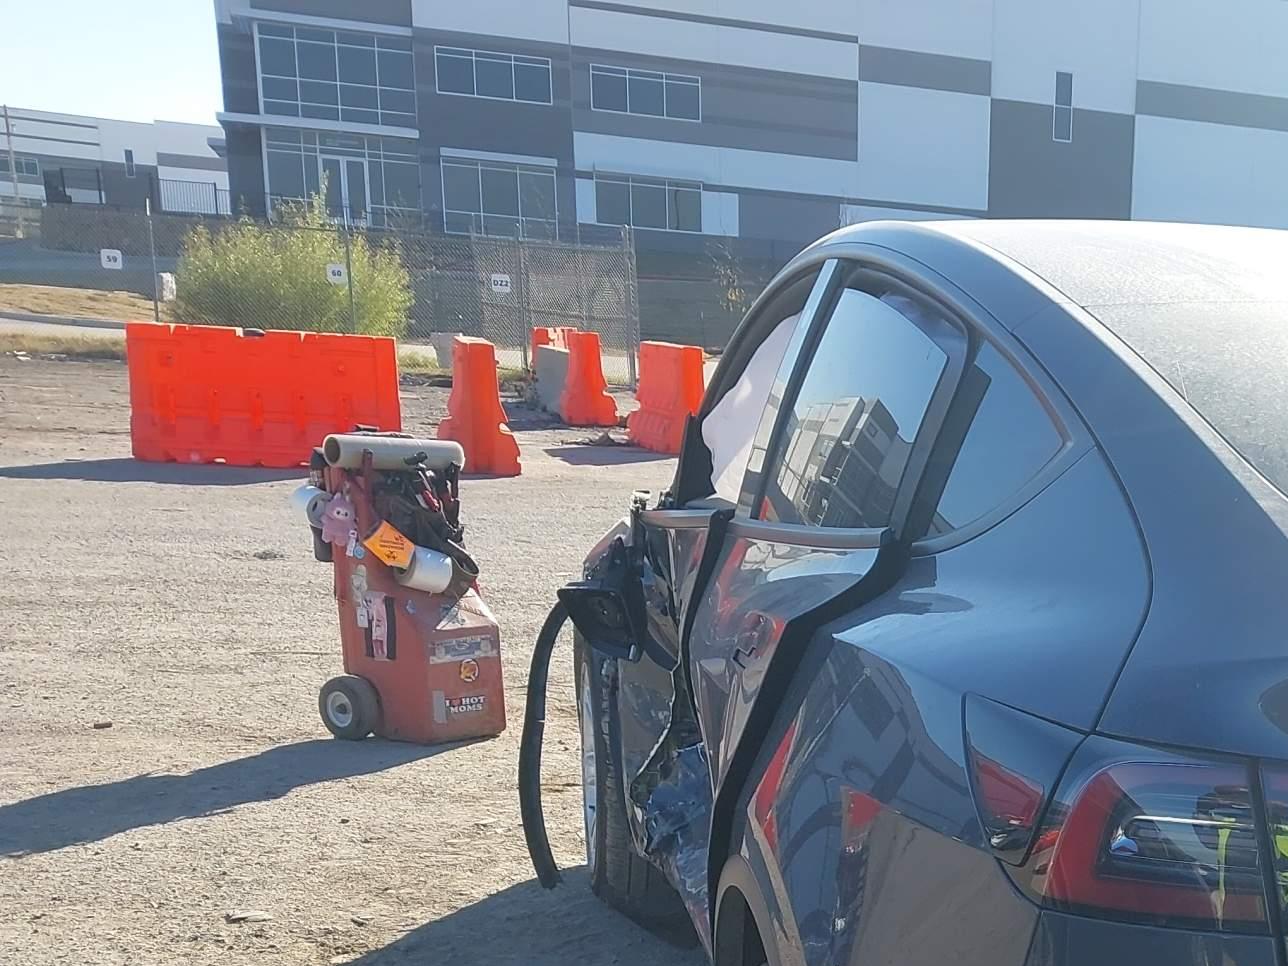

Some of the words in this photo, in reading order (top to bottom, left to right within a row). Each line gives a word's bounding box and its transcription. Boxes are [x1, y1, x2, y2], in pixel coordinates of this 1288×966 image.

[106, 255, 118, 263] 59
[462, 696, 486, 706] HOT
[450, 703, 483, 714] MOMS
